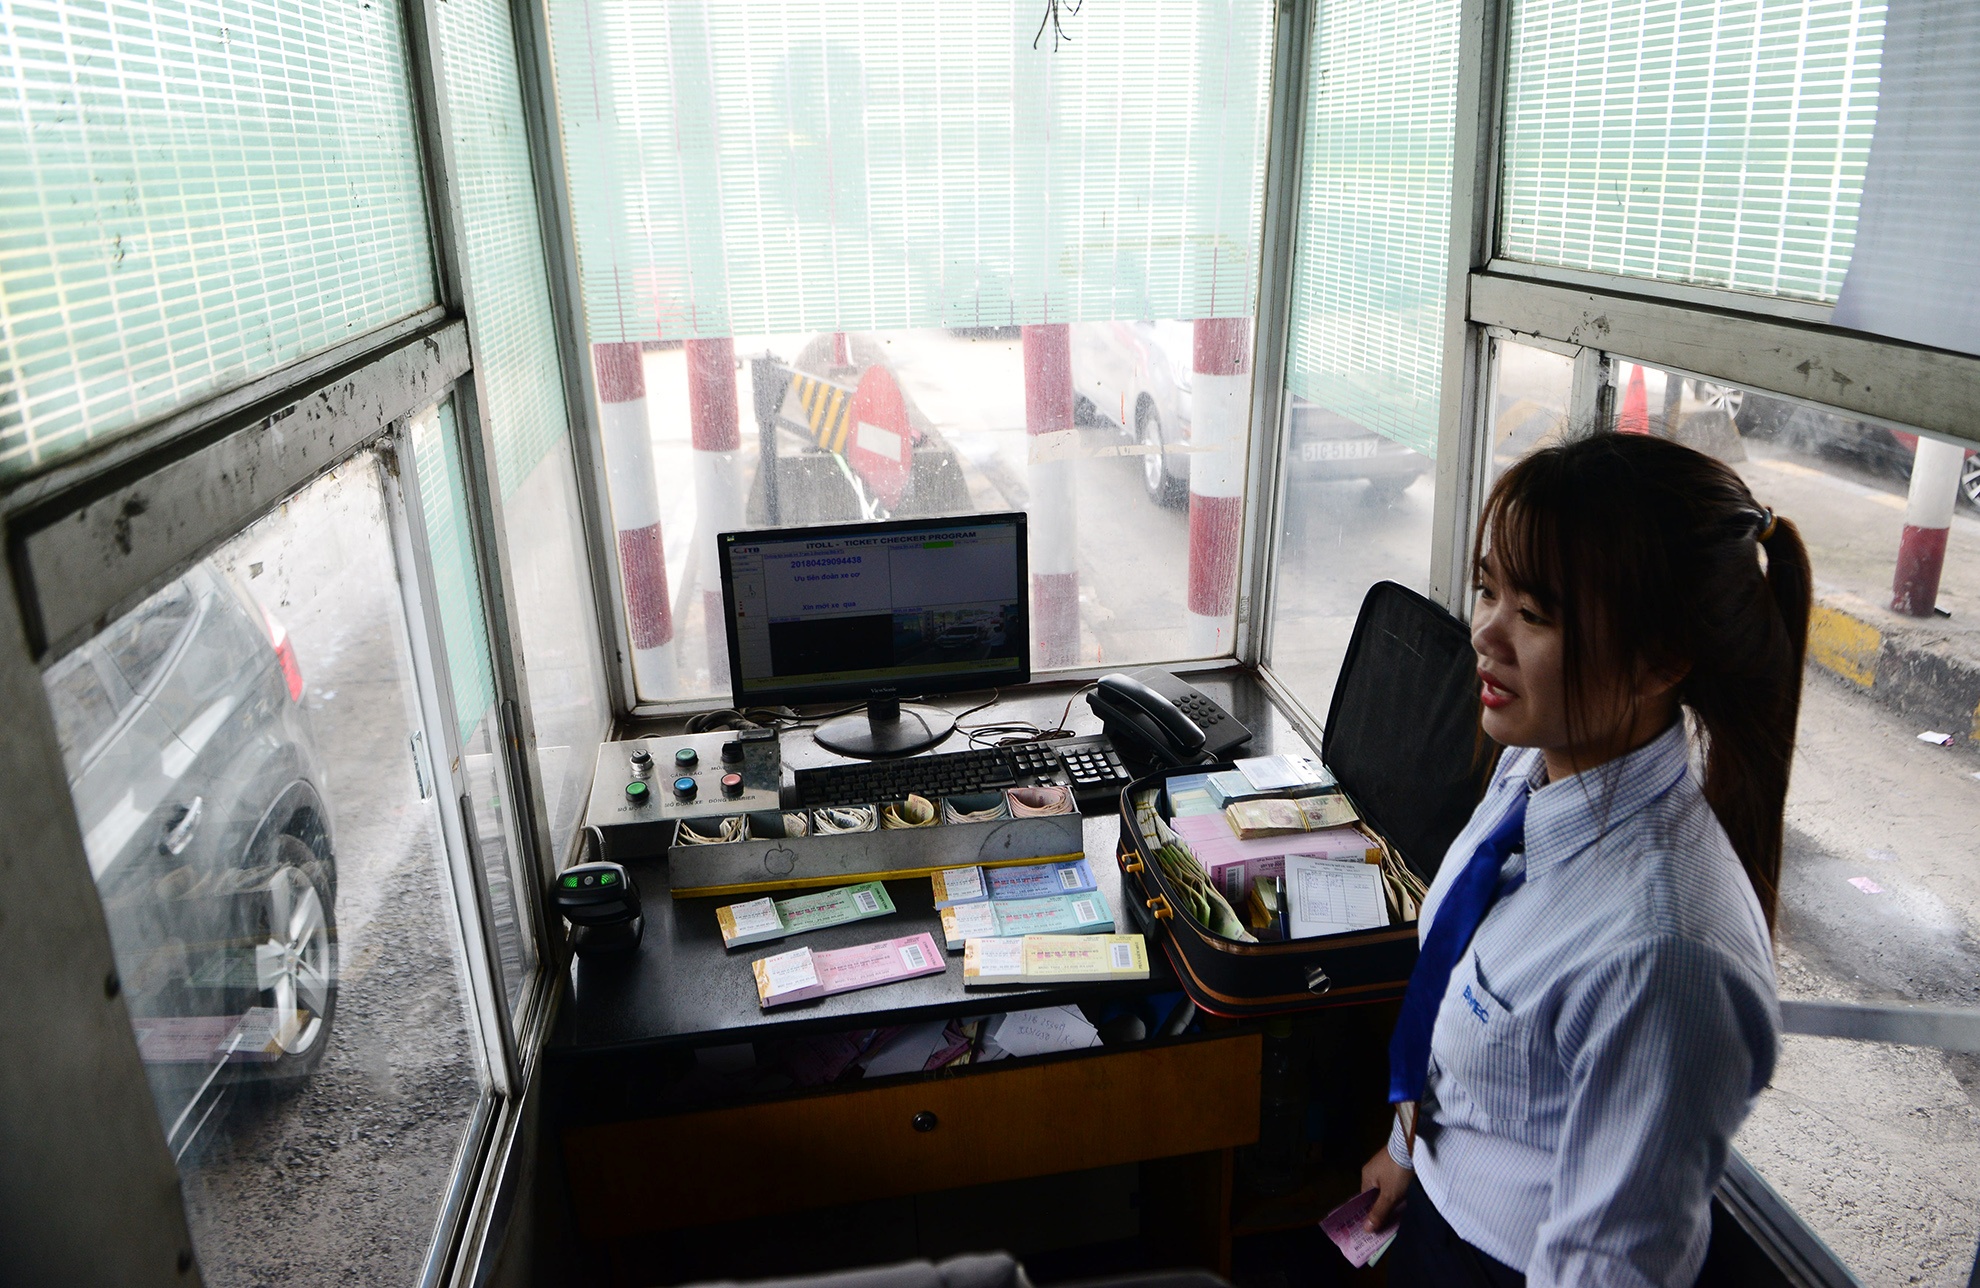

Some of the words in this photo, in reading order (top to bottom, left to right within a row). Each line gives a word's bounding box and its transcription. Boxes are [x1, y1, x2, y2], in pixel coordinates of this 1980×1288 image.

[844, 538, 878, 546] TICKET
[880, 534, 926, 544] CHECKER
[928, 532, 977, 540] PROGRAM
[790, 556, 862, 568] 20180429094438
[842, 601, 856, 609] qua
